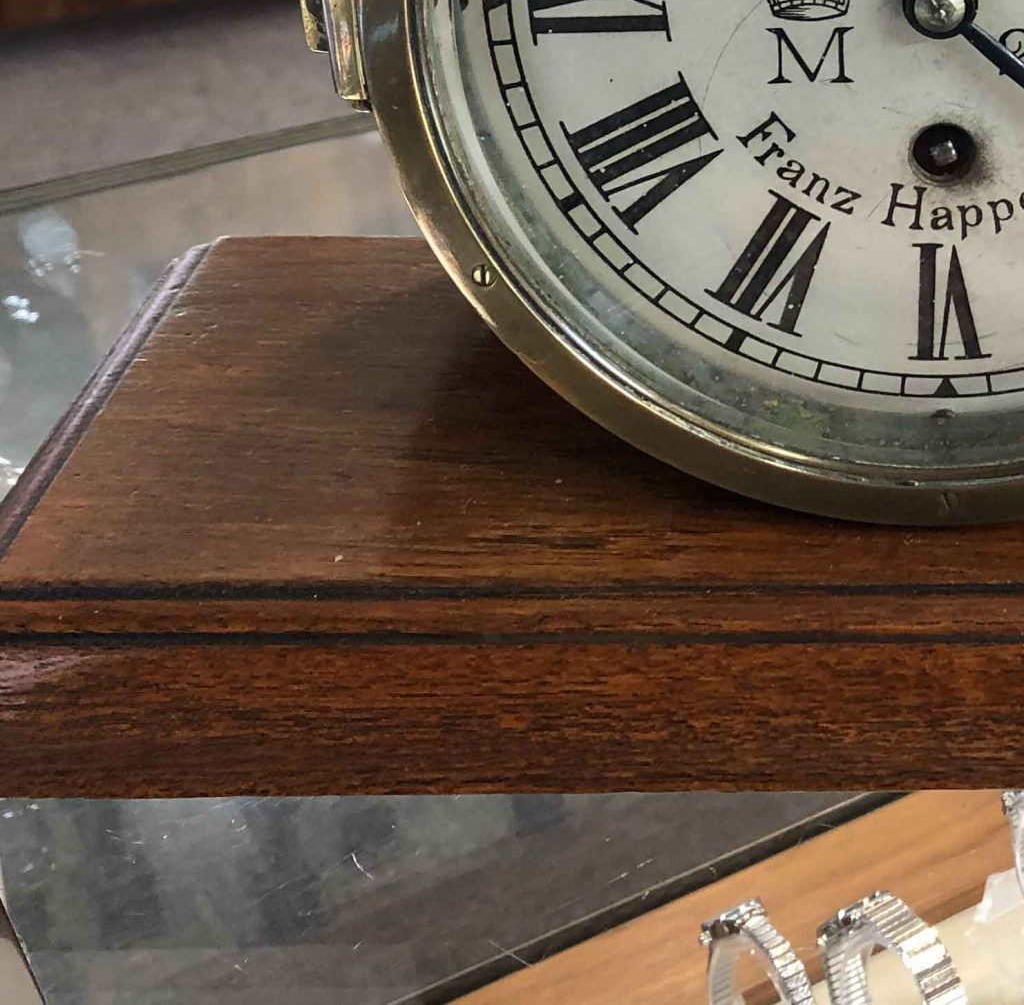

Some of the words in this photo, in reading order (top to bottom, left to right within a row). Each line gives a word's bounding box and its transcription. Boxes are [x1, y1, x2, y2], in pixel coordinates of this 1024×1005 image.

[765, 25, 854, 84] M
[558, 71, 724, 235] VIII
[736, 111, 862, 216] Franz
[703, 189, 832, 337] VII
[907, 243, 992, 361] VI
